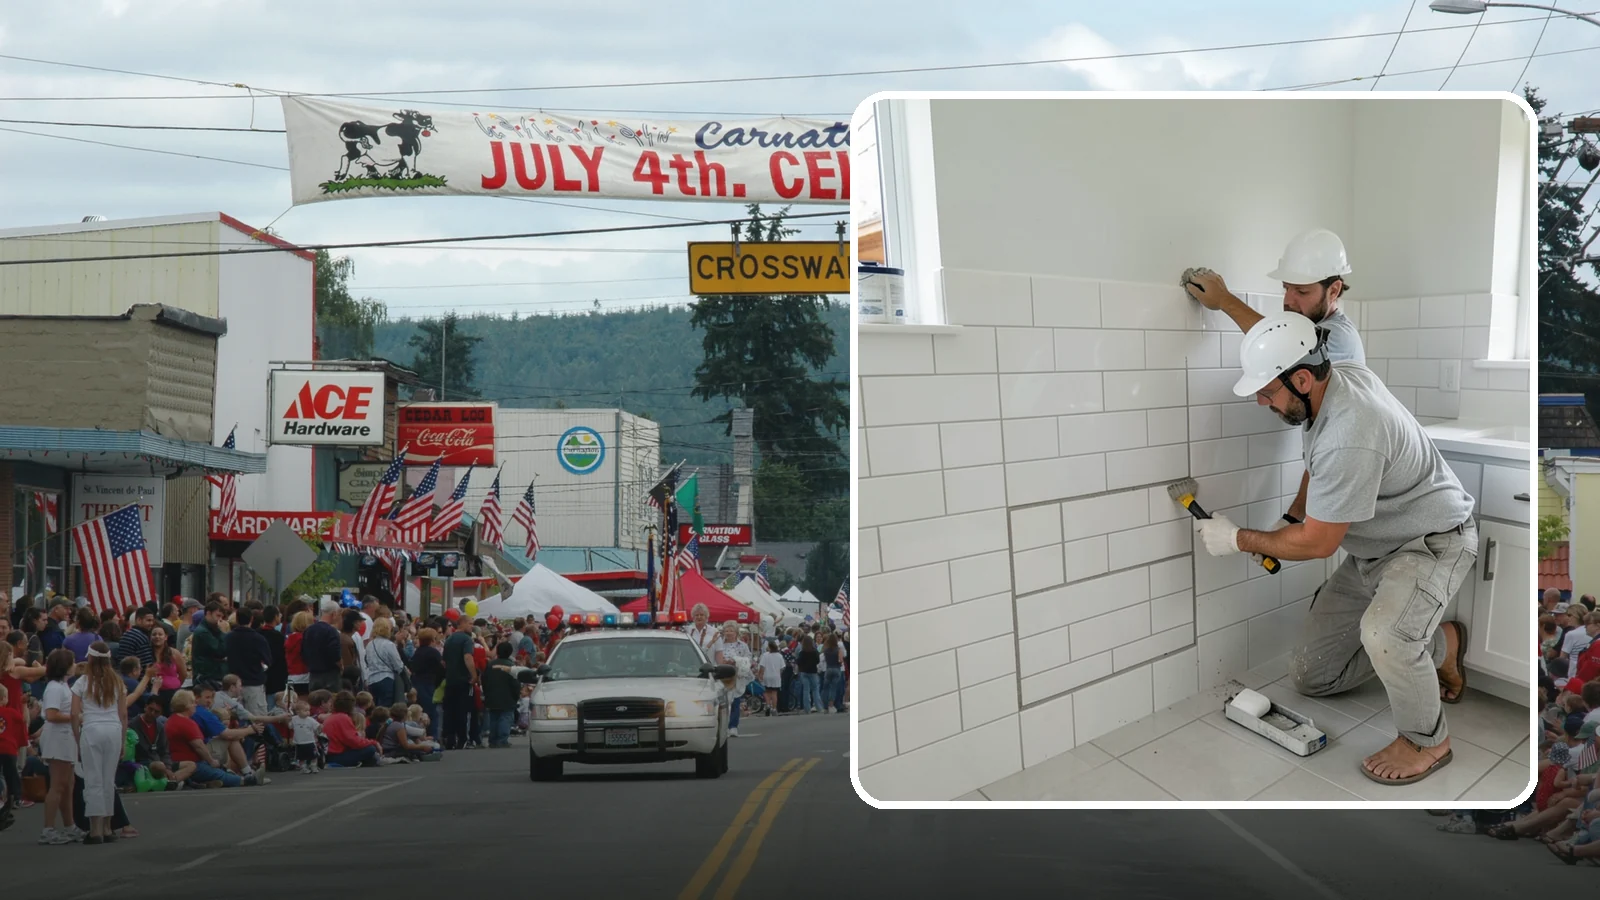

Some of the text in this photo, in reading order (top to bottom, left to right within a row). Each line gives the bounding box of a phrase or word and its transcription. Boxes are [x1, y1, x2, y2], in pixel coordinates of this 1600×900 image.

[481, 141, 605, 192] JULY
[632, 150, 747, 198] 4th.
[697, 254, 850, 279] CROSSWA
[283, 380, 373, 419] ACE
[405, 409, 452, 422] CEDAR
[284, 421, 370, 436] Hardware
[417, 428, 476, 446] Coca-Cola
[354, 467, 385, 480] Simpl
[95, 485, 124, 494] Vincent
[126, 485, 136, 495] de
[137, 486, 155, 495] Paul
[688, 526, 741, 535] CRNATION
[699, 535, 730, 543] GLASS
